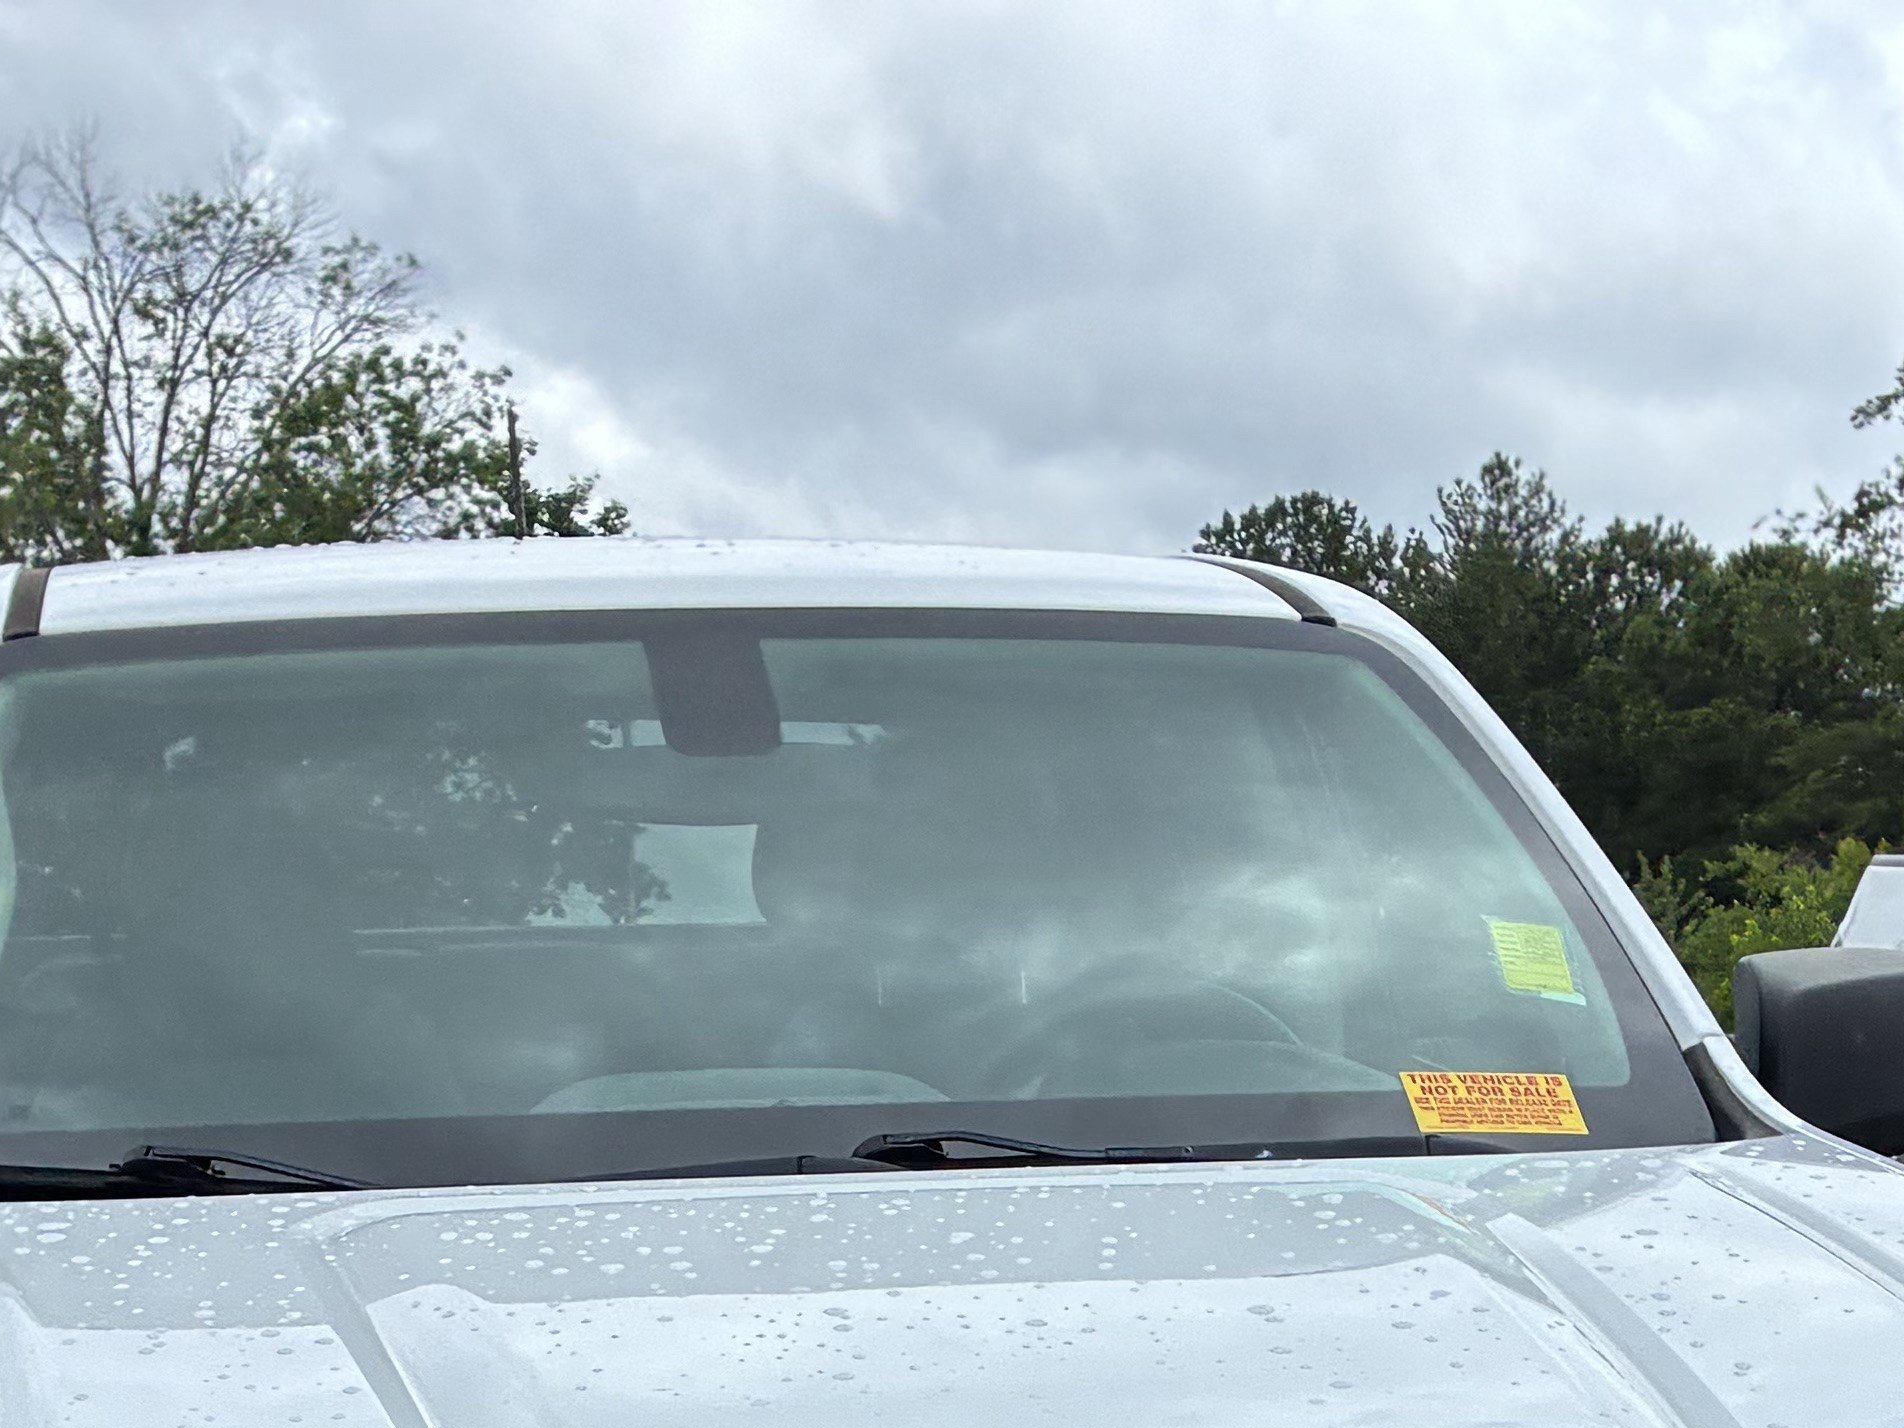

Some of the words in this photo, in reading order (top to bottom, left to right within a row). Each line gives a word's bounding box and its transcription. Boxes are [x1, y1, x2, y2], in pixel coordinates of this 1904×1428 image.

[1407, 1074, 1453, 1085] THIS
[1456, 1074, 1539, 1086] VEHICLE
[1543, 1076, 1563, 1087] IS
[1420, 1085, 1459, 1096] NOT
[1465, 1086, 1506, 1097] FOR
[1508, 1087, 1559, 1098] SALE
